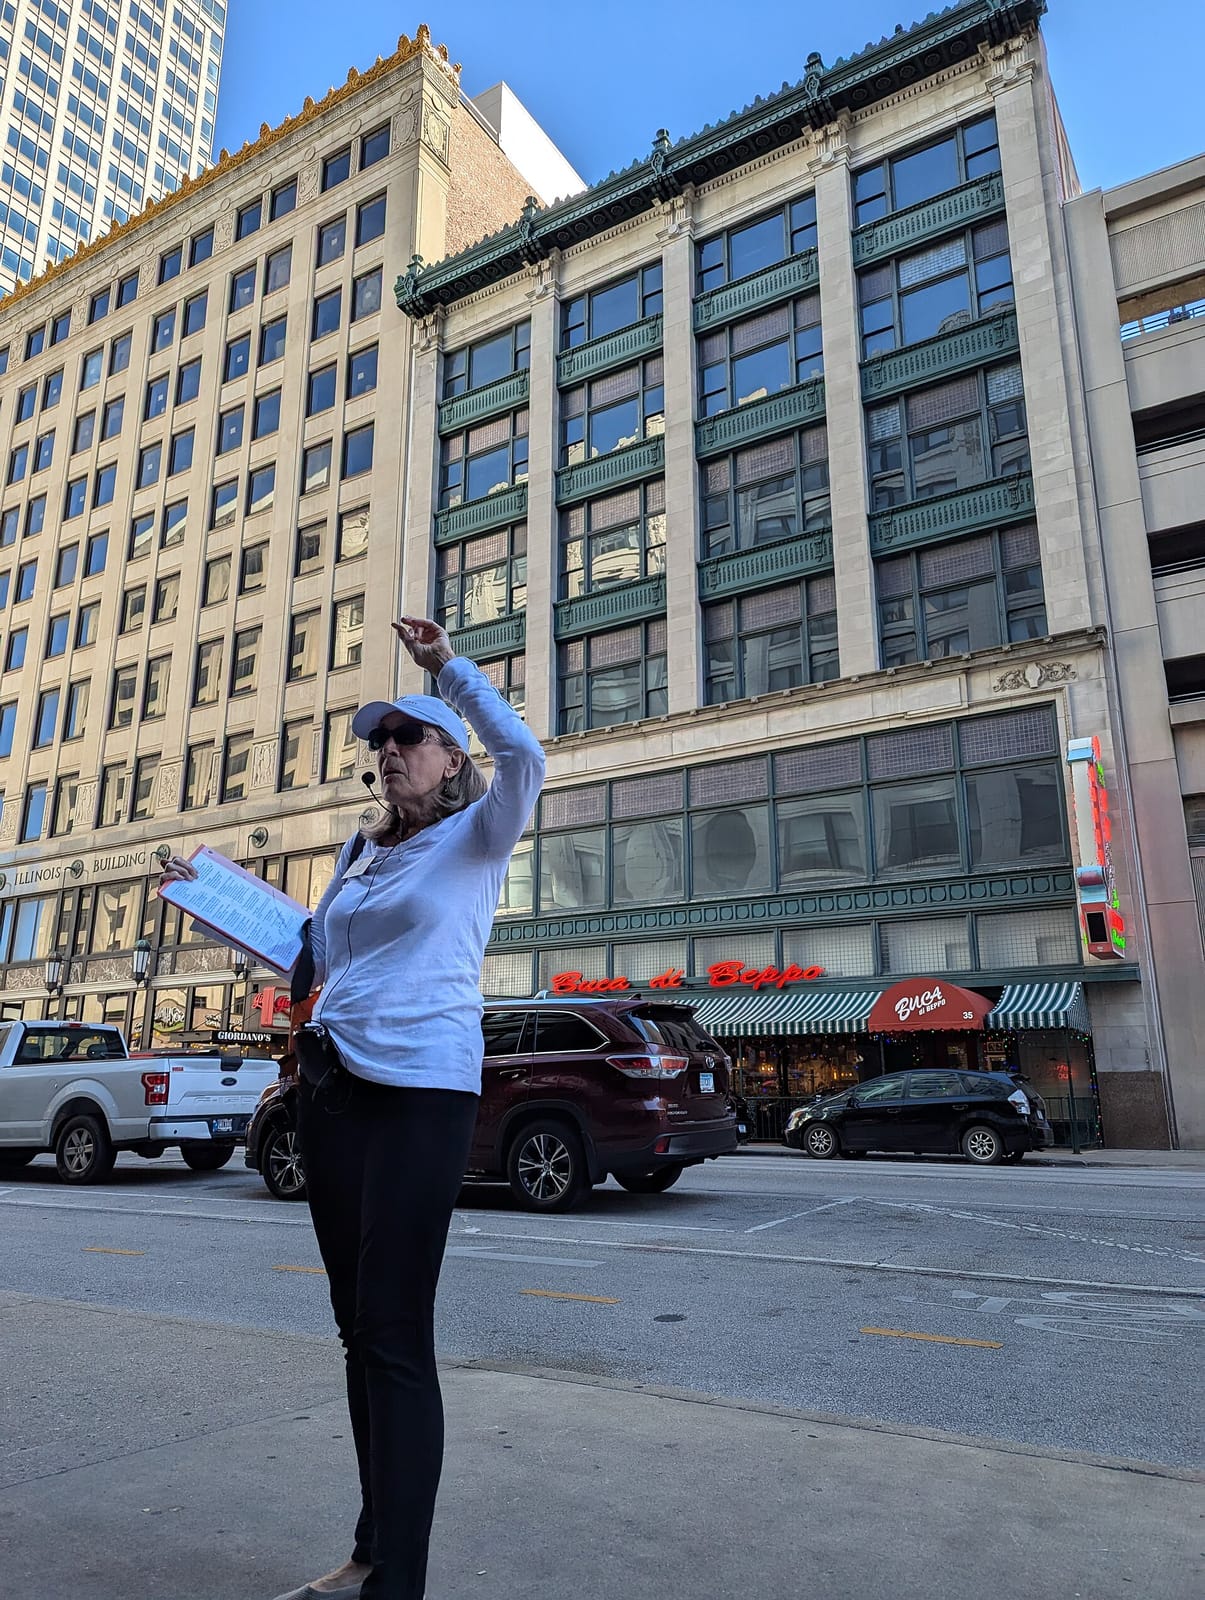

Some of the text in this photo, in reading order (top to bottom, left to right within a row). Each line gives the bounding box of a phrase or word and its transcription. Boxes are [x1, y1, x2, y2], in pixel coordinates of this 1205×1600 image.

[14, 852, 146, 886] ILLINOIS BUILDING
[551, 960, 826, 994] Buca di Beppo
[895, 986, 943, 1021] BUCA
[918, 999, 946, 1016] di BEPPO
[963, 1011, 974, 1020] 35
[217, 1031, 272, 1042] GIORDANO'S
